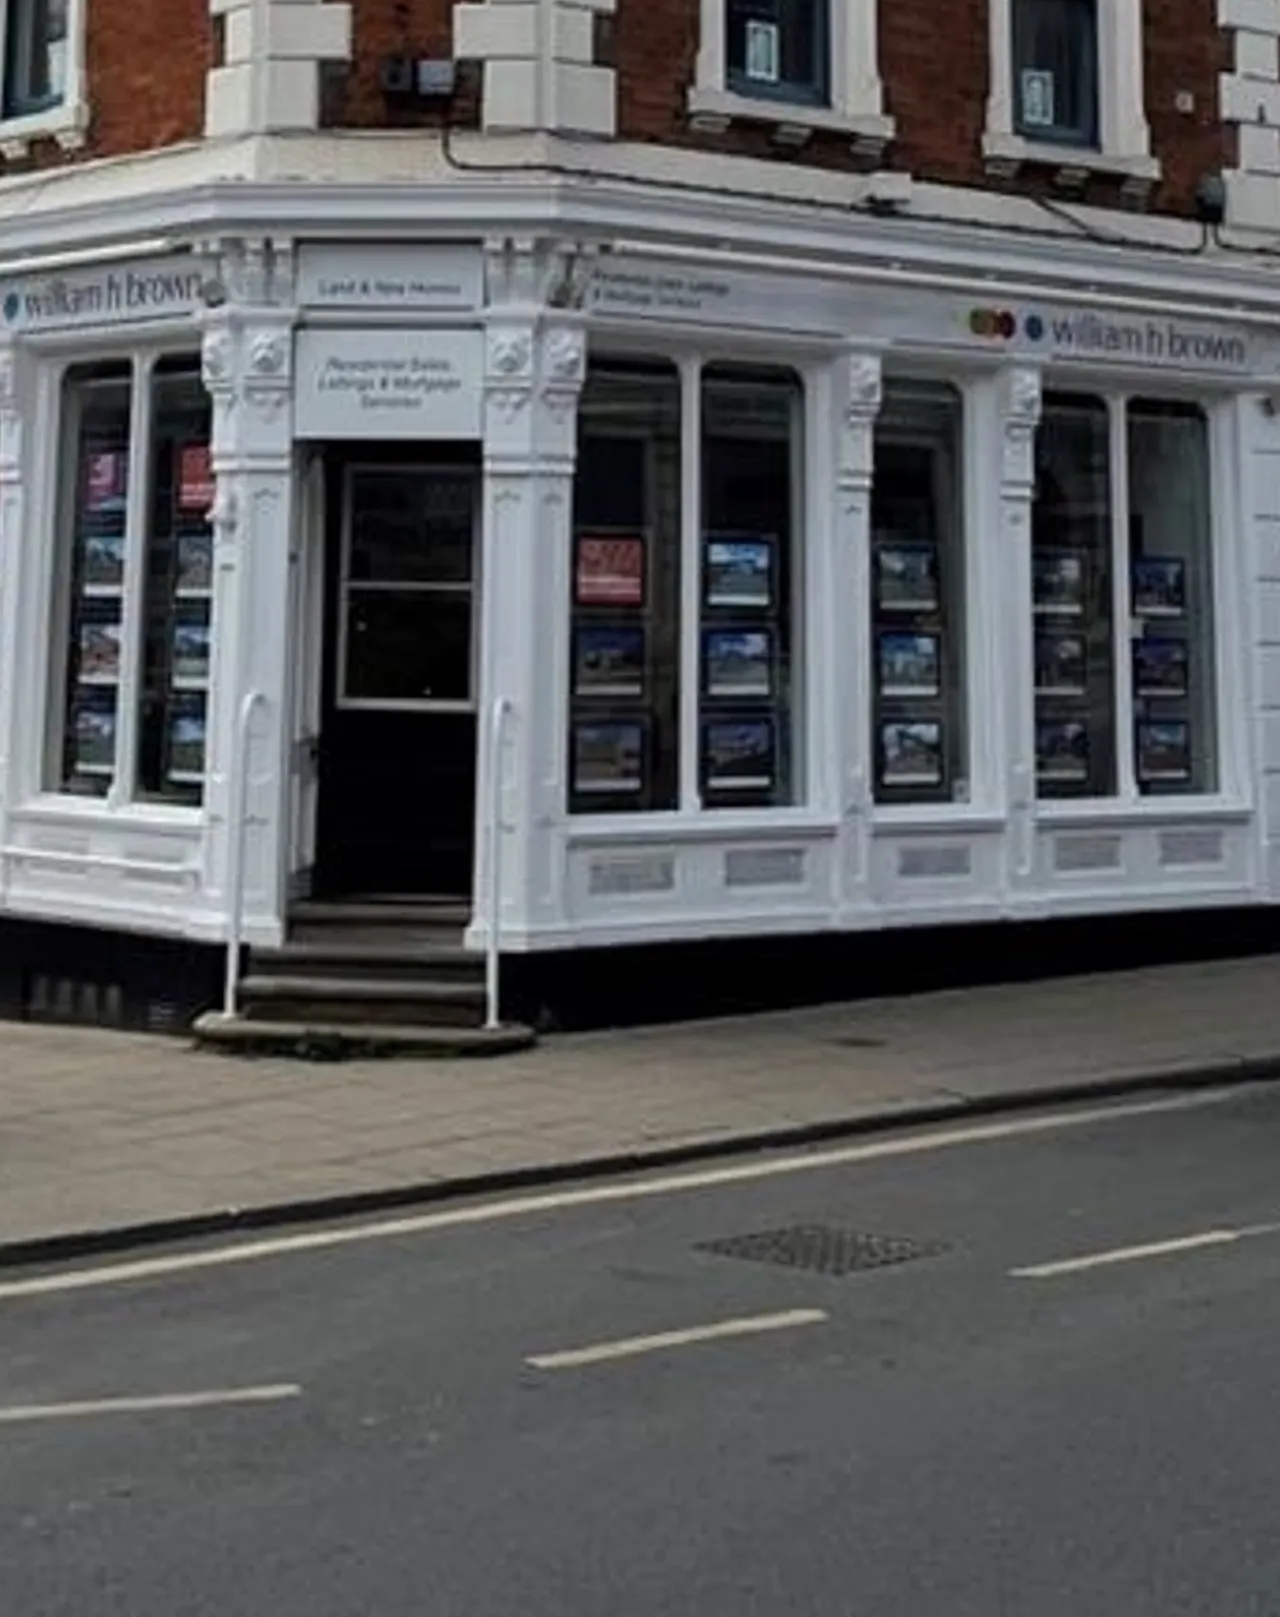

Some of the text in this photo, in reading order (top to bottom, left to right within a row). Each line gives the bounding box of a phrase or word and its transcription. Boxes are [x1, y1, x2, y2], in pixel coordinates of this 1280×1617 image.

[23, 271, 203, 318] william h brown
[1052, 314, 1246, 364] william h brown
